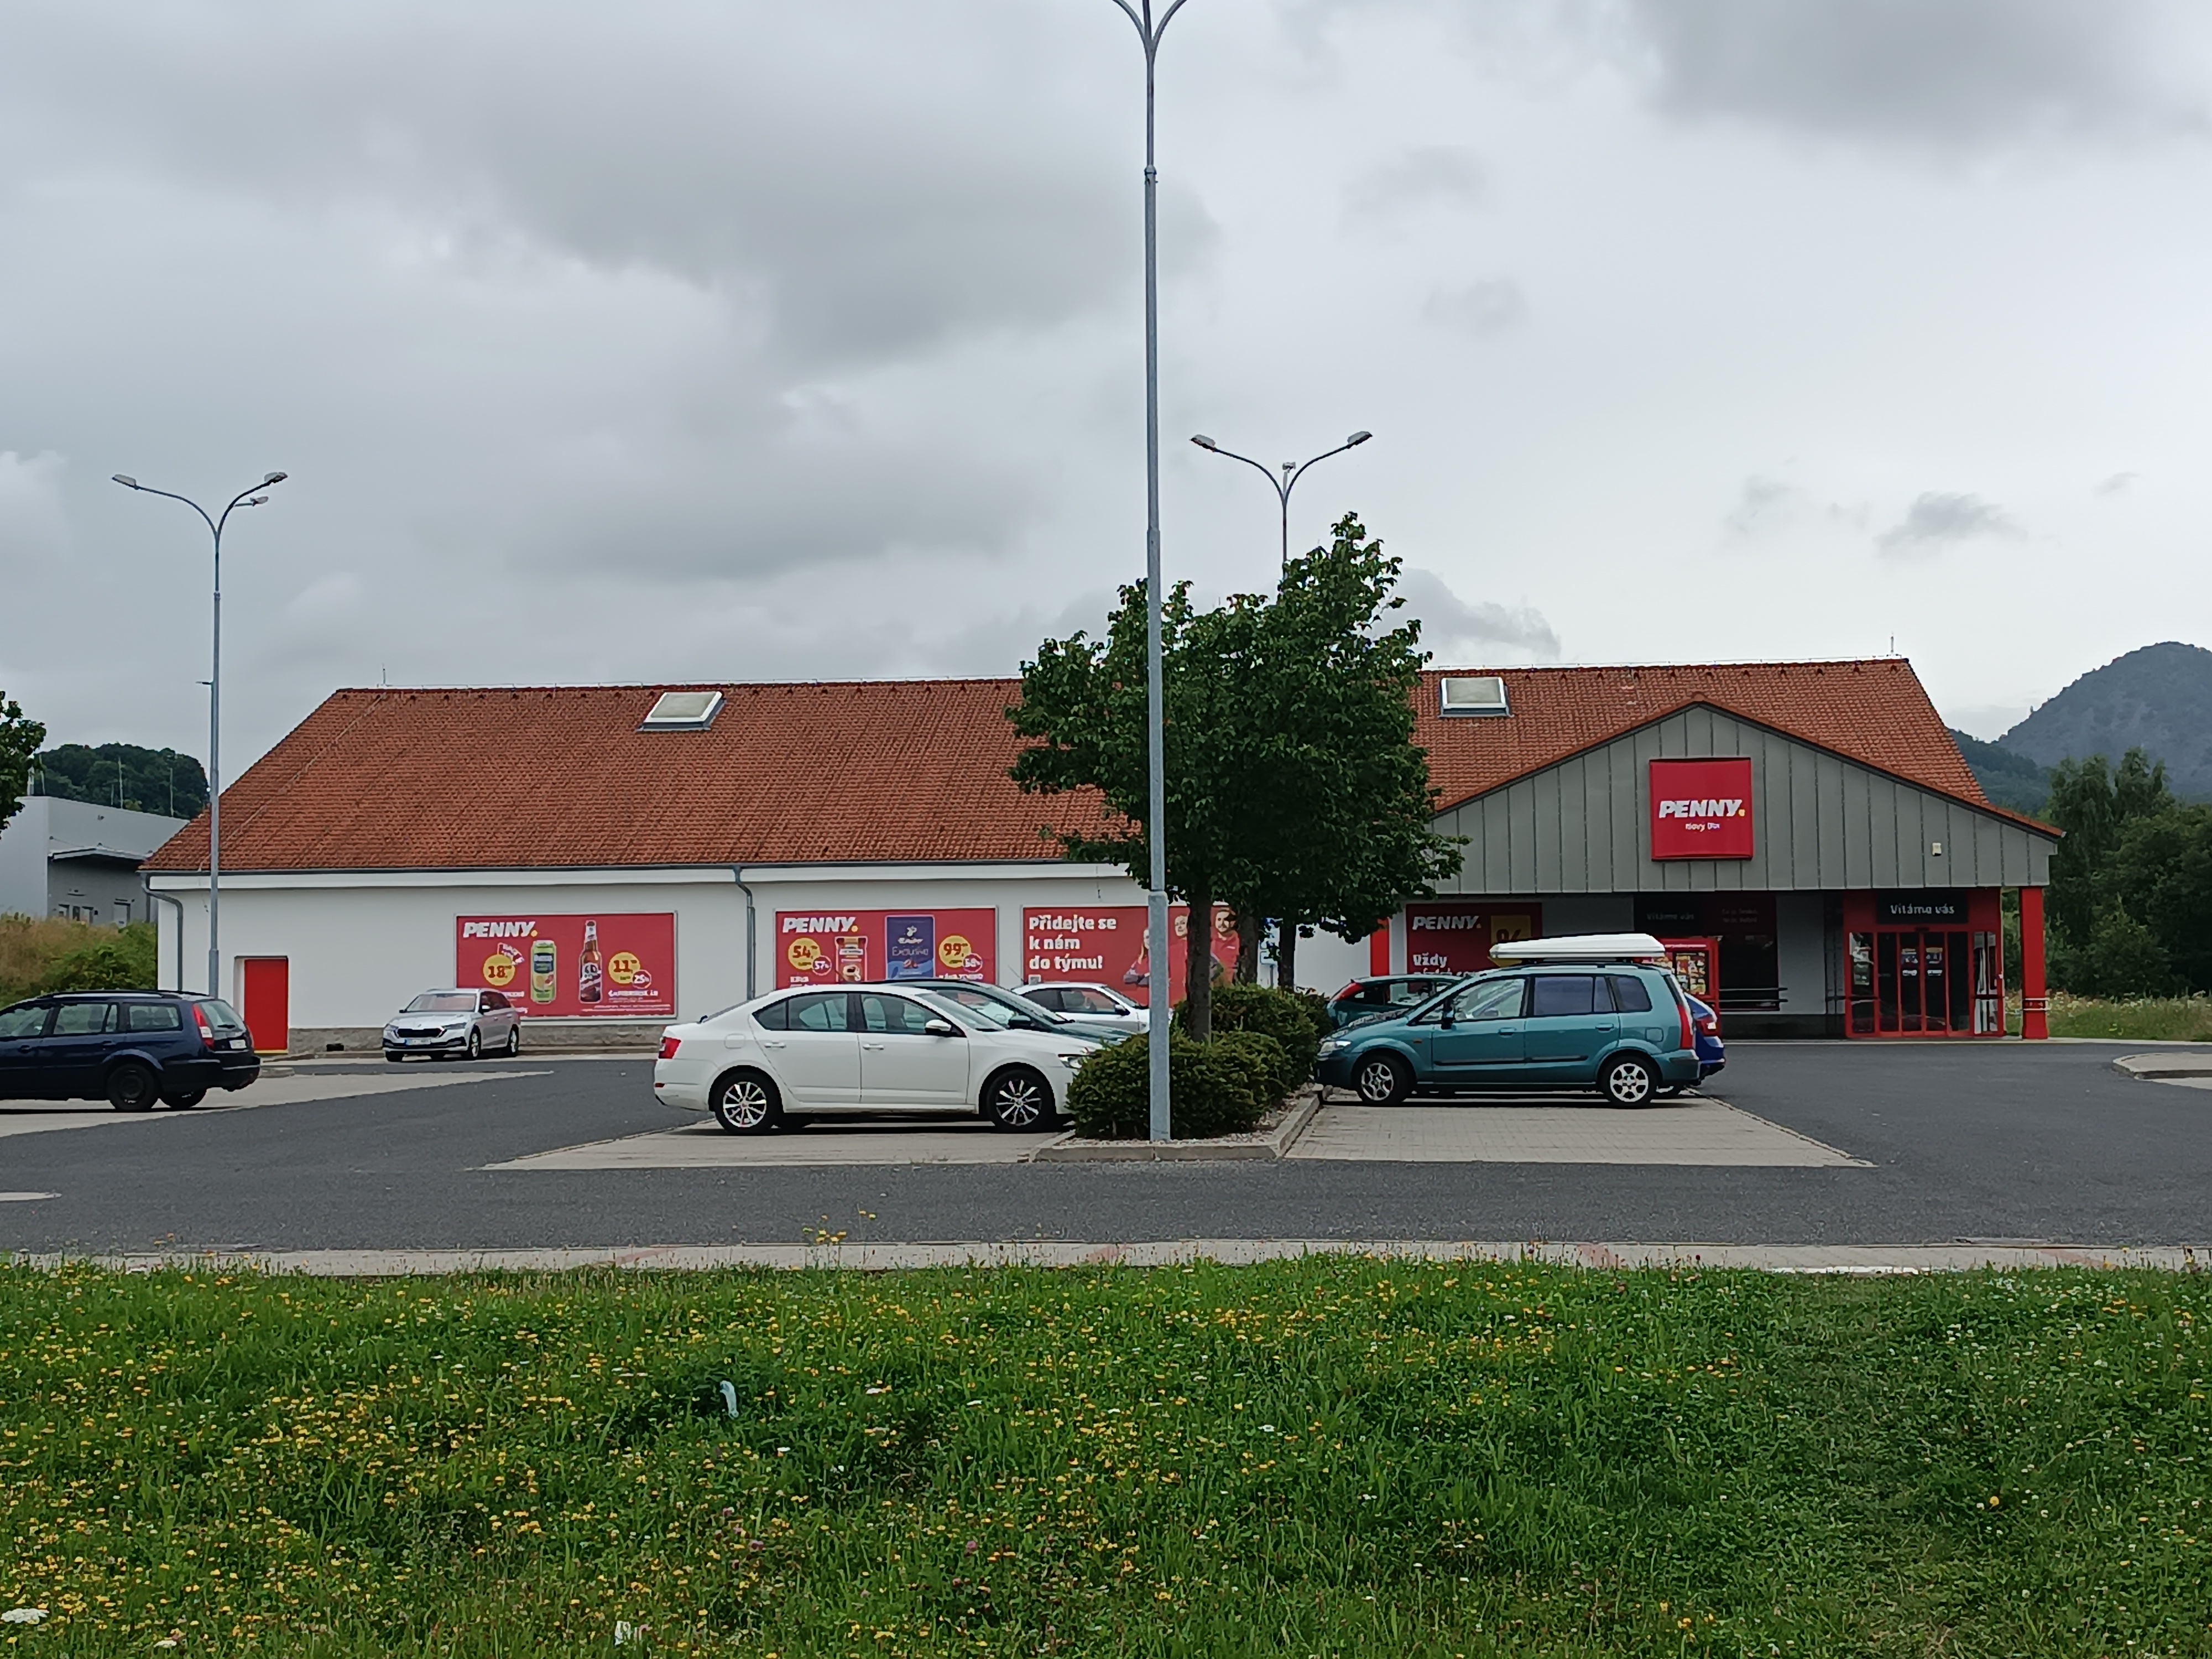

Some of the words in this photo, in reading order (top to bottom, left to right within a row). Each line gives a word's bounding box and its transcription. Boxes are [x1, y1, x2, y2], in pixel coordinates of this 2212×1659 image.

[1029, 915, 1094, 933] Přidejte
[1098, 918, 1117, 930] se
[1029, 936, 1040, 950] k
[1044, 934, 1080, 950] nám
[1029, 955, 1050, 969] do
[1054, 953, 1103, 972] týmu!
